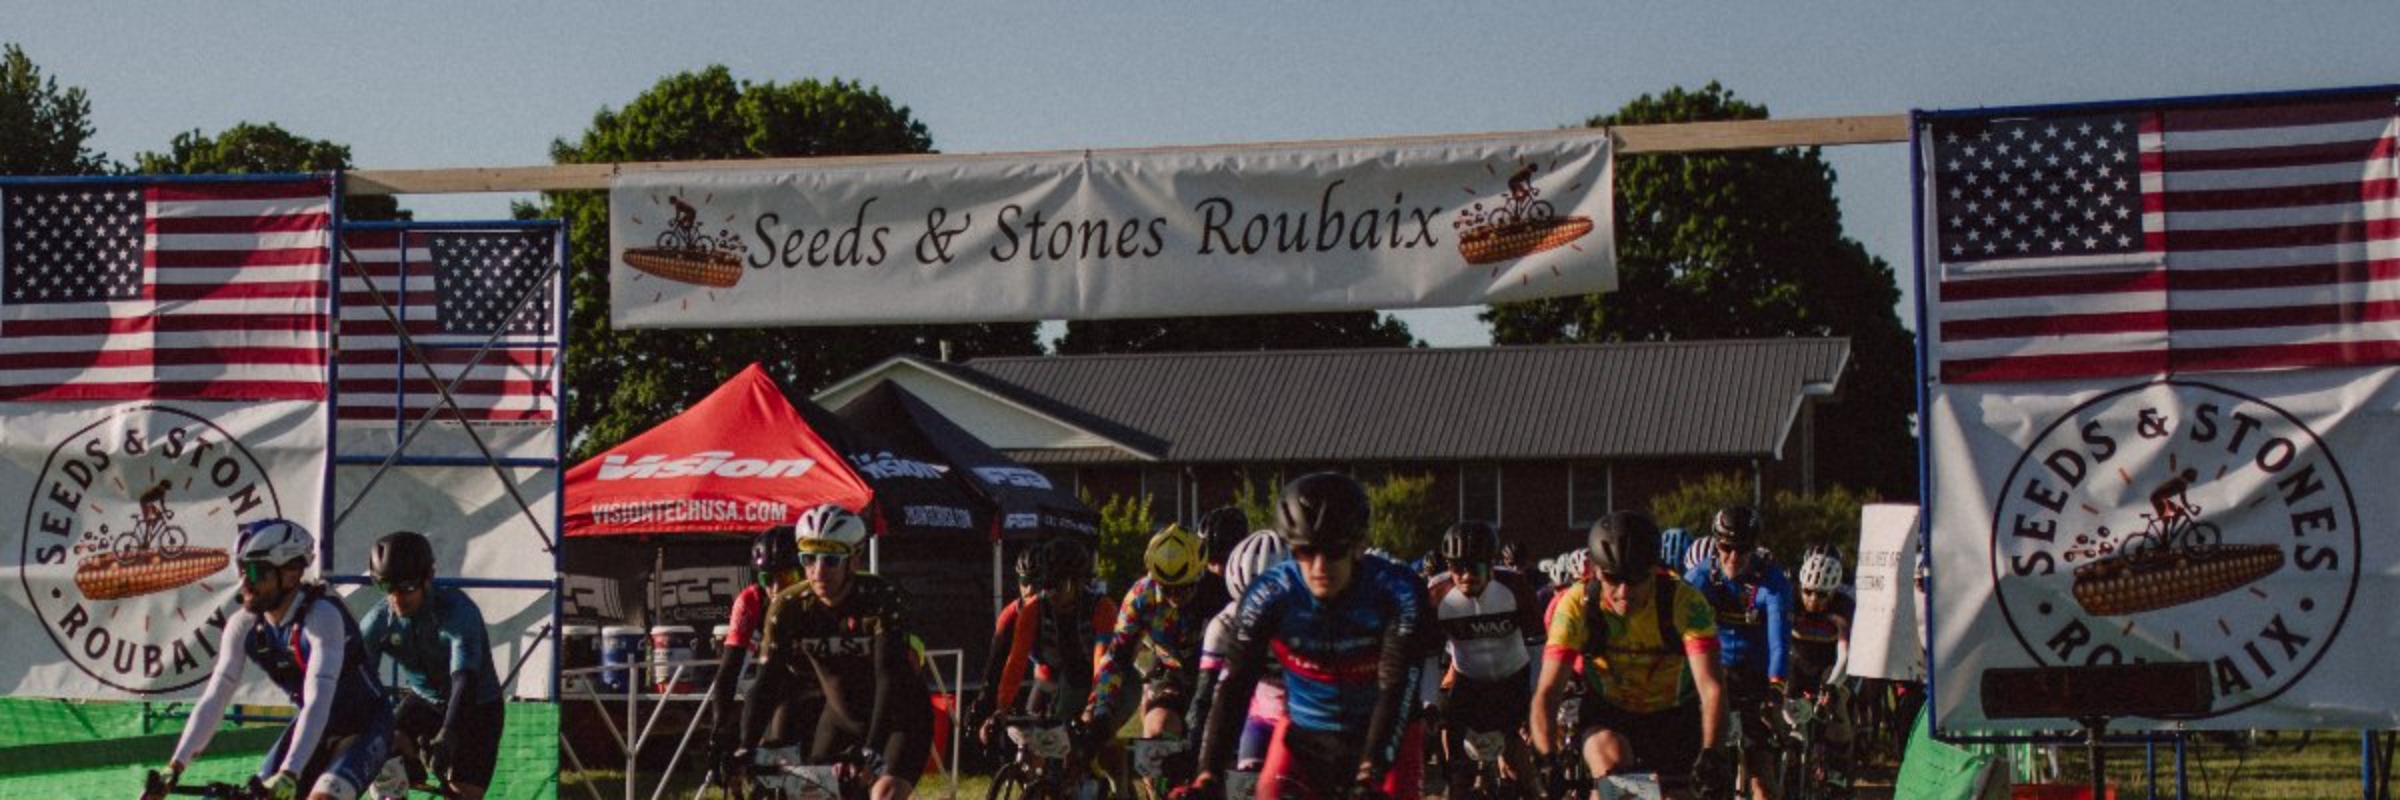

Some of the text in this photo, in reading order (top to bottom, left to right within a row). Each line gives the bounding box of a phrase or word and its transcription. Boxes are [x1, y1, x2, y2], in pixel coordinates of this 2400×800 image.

[748, 179, 1443, 269] Seeds & Stones Roubaix
[36, 427, 263, 565] SEEDS & STON
[597, 451, 816, 480] Vision
[2012, 404, 2338, 577] SEEDS & STONES
[592, 499, 787, 524] VISIONTECHUSA.COM
